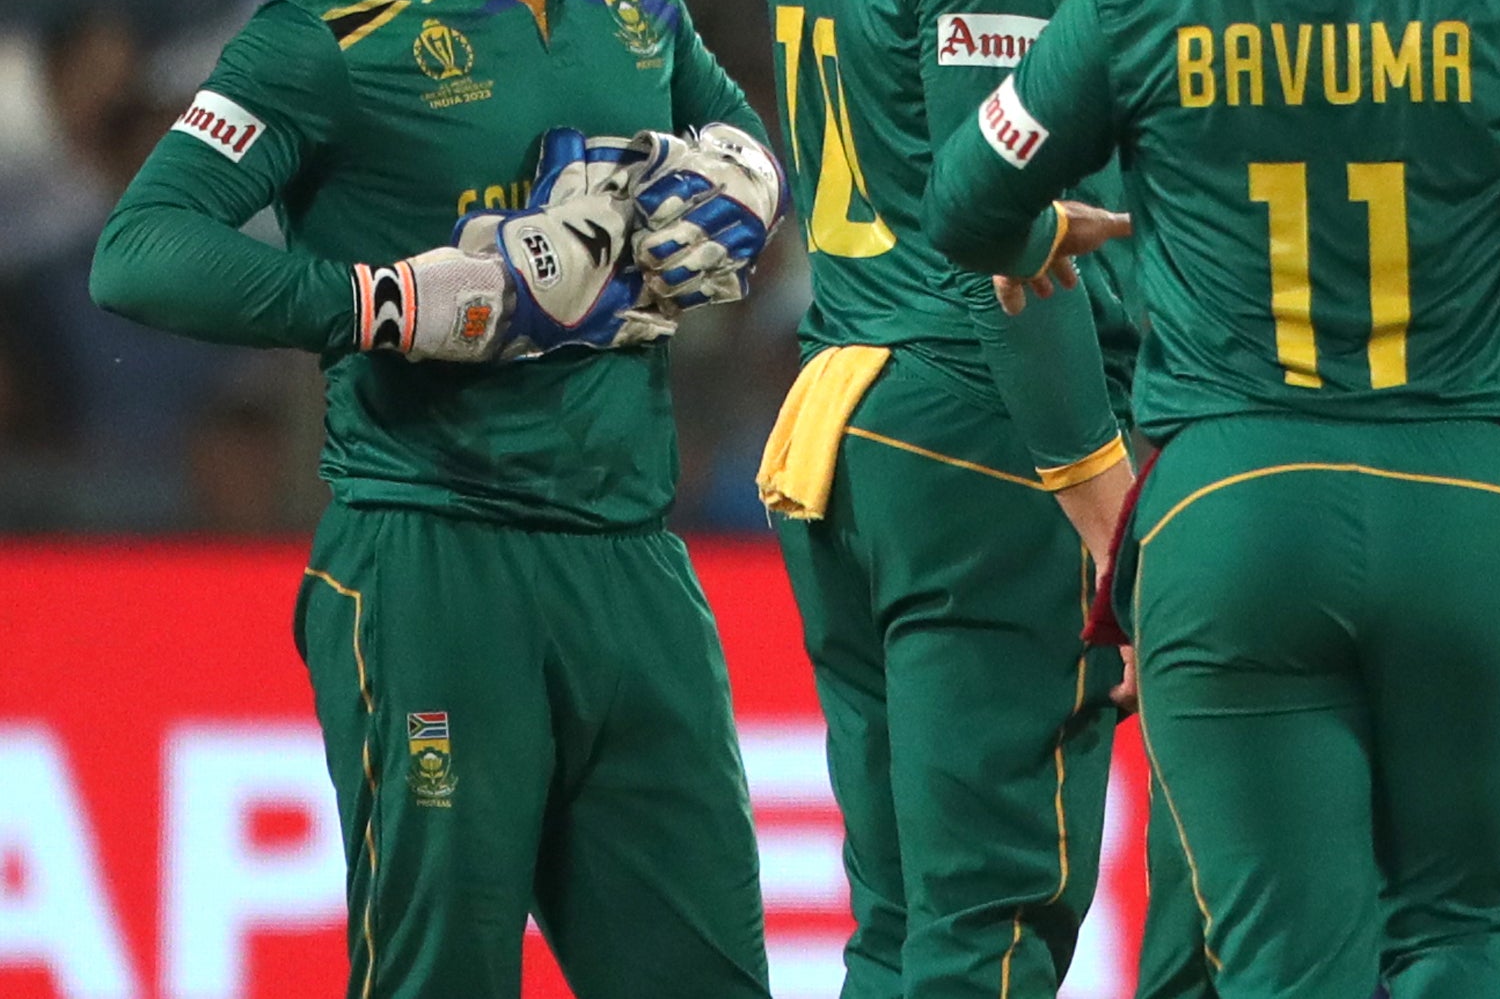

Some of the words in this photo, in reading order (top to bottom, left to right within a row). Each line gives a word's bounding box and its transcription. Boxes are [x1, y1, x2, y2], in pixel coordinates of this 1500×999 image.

[1177, 20, 1472, 108] BAVUMA
[181, 106, 256, 153] mul
[985, 95, 1040, 161] mul
[522, 234, 557, 279] SS
[1248, 161, 1411, 389] 11
